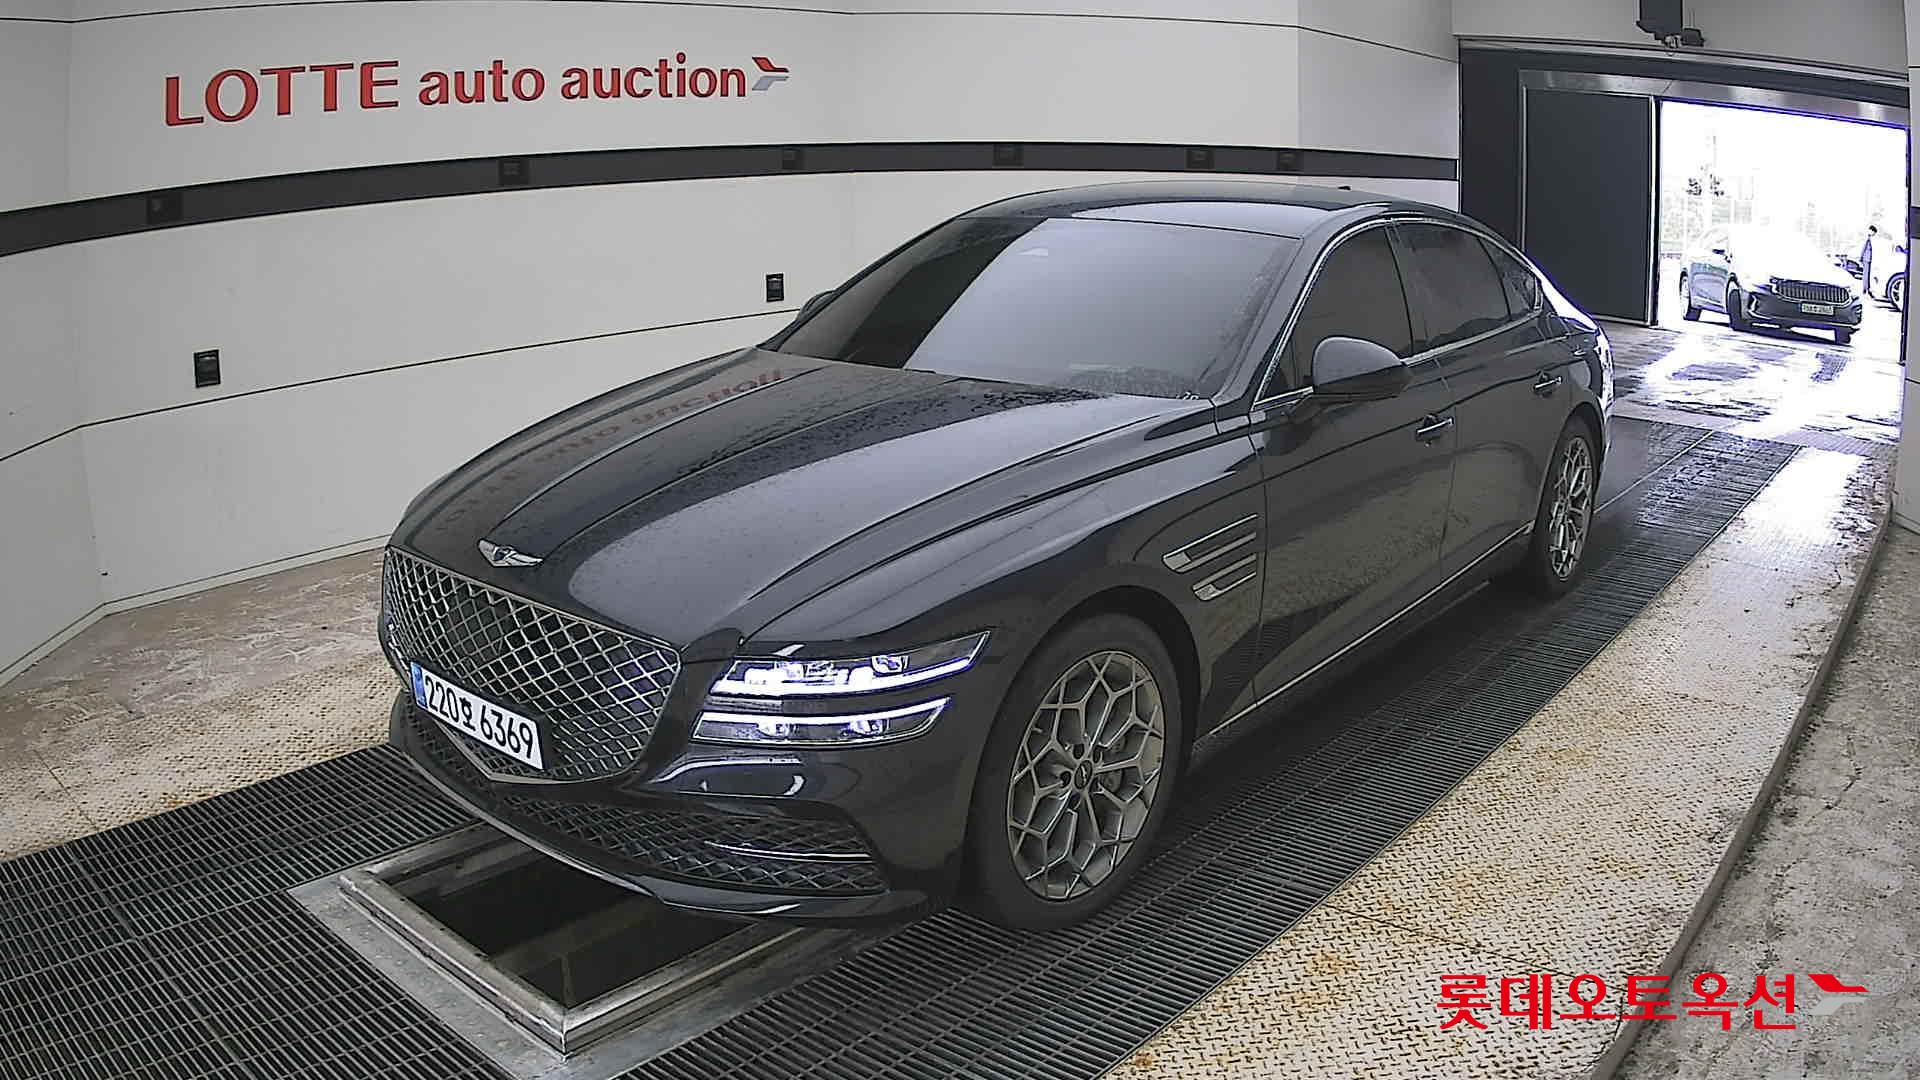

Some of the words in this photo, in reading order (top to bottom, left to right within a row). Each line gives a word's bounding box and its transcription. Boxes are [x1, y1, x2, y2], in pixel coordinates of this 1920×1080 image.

[165, 61, 400, 127] LOTTE
[419, 60, 547, 105] auto
[560, 52, 748, 100] auction
